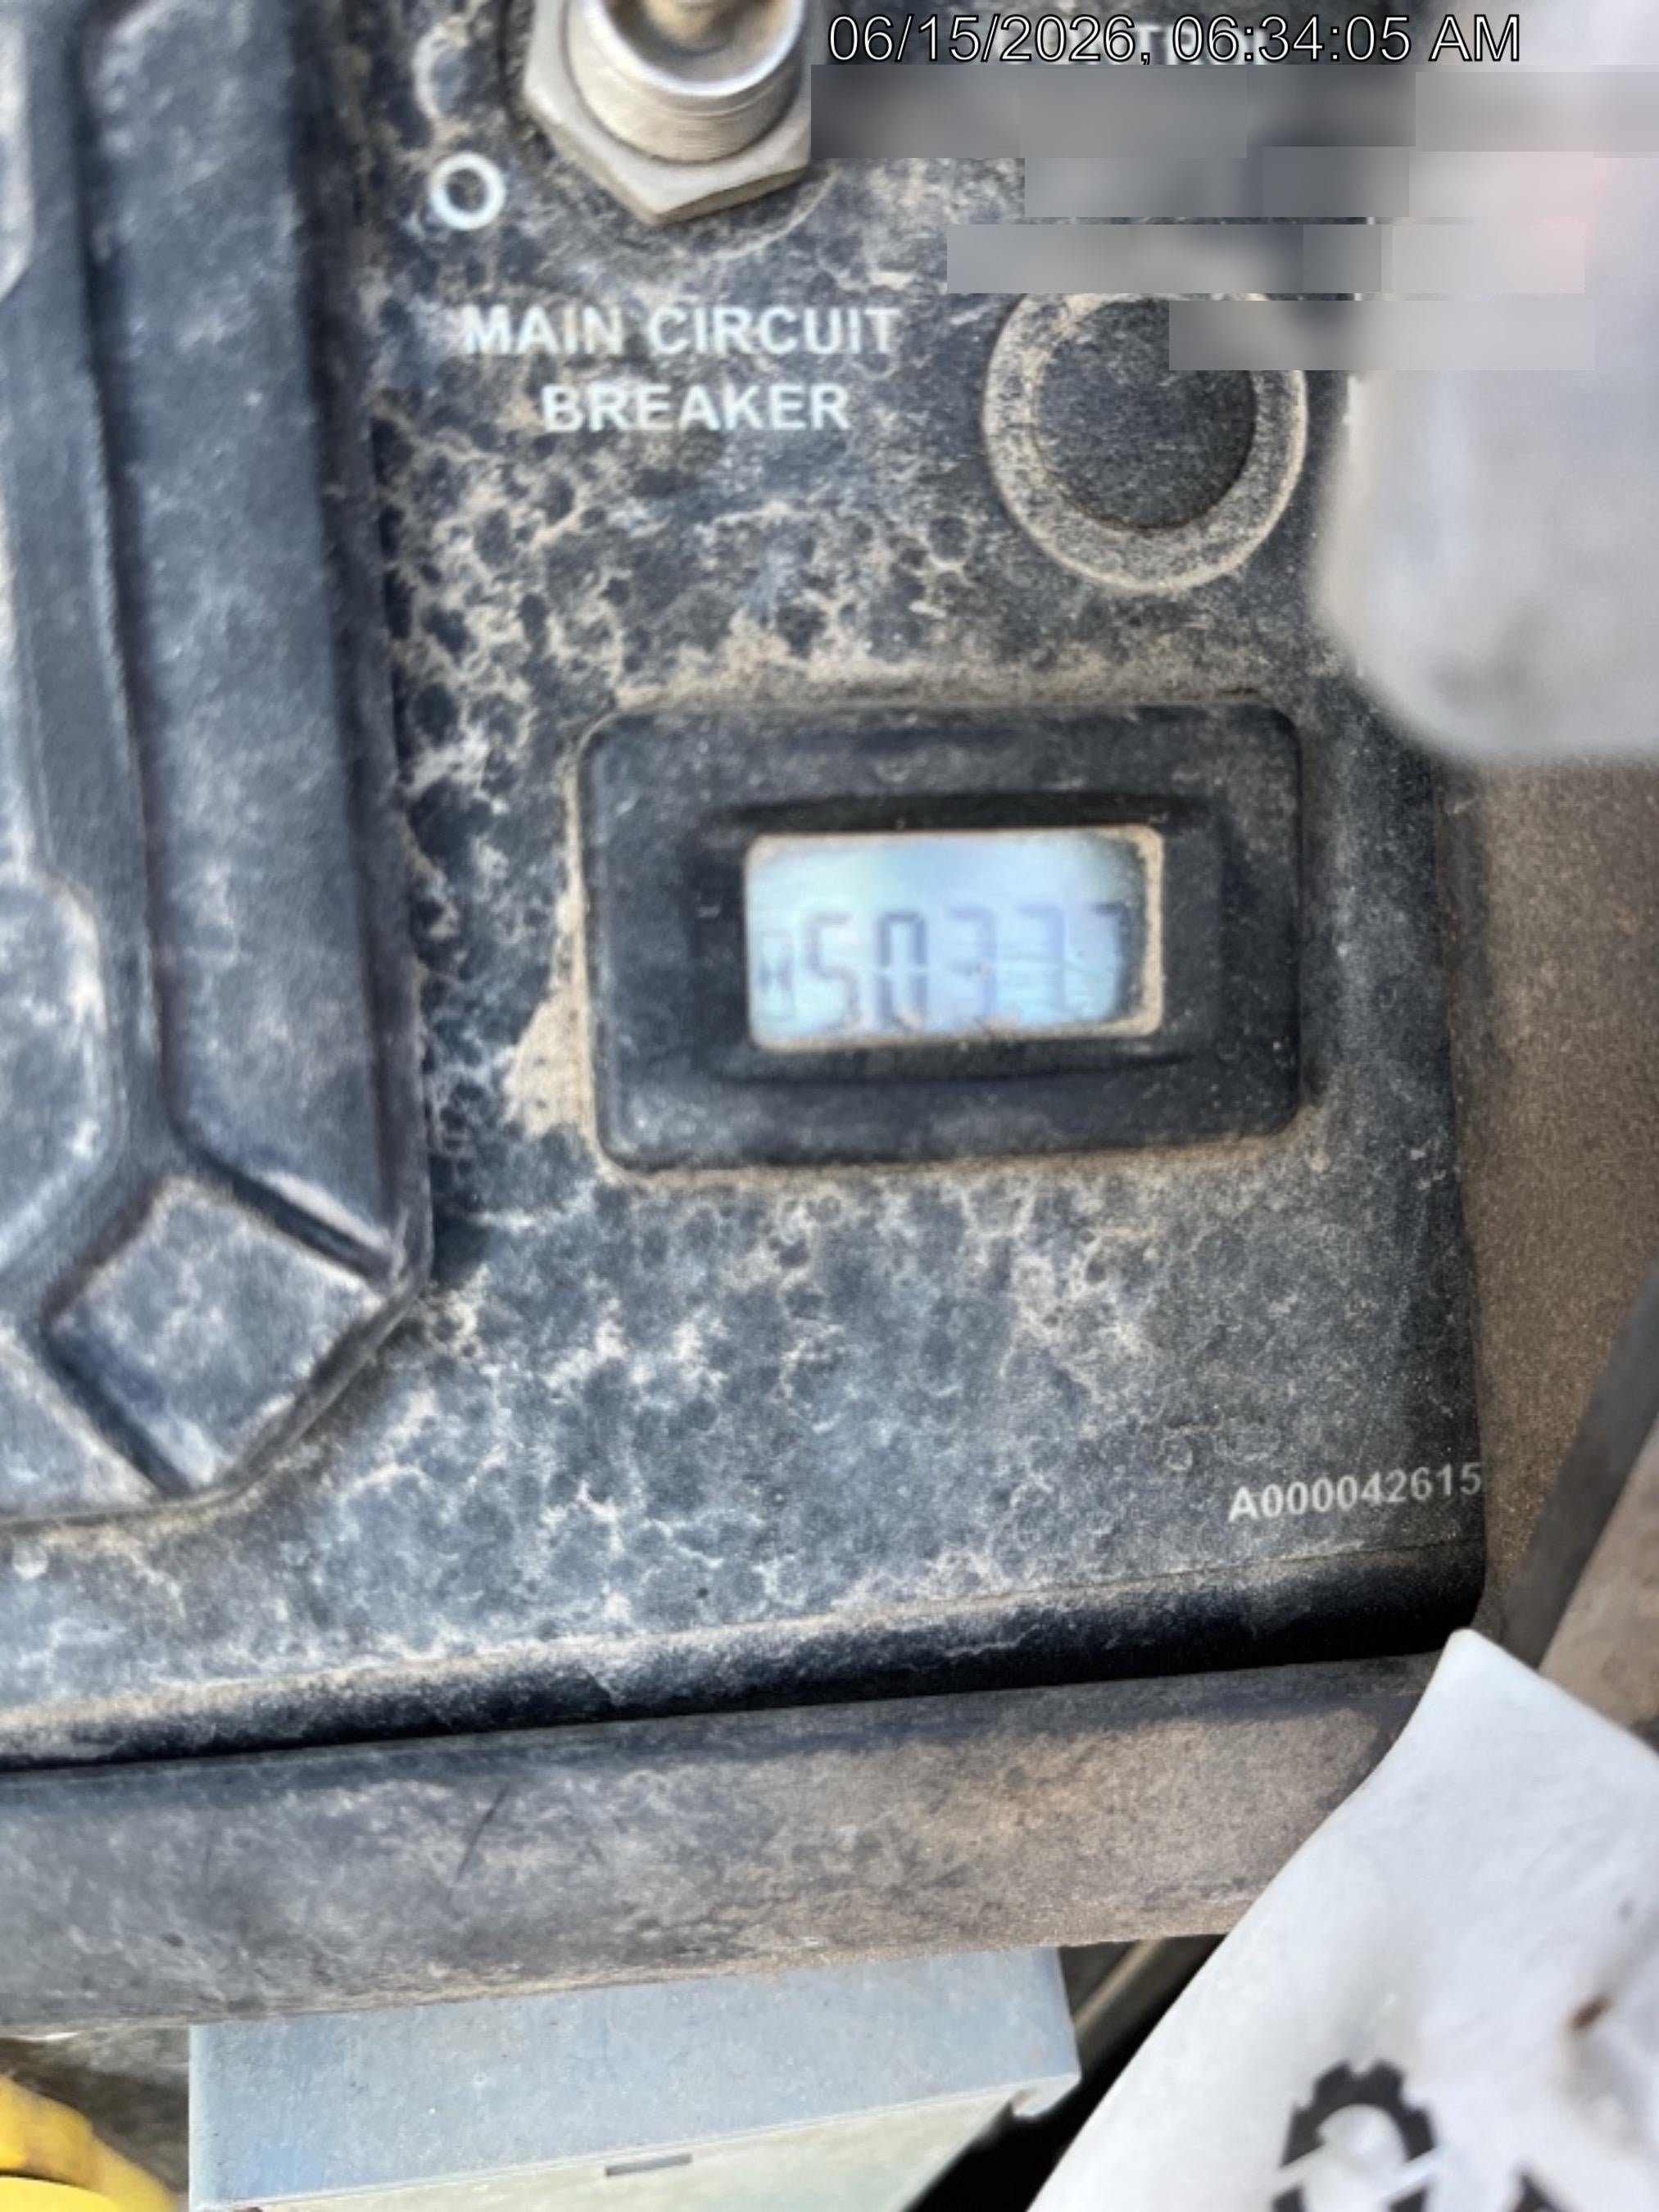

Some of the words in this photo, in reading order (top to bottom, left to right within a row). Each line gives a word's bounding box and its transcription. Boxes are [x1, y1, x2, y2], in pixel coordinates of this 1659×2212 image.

[461, 304, 623, 356] MAIN
[647, 304, 900, 356] CIRCUIT
[541, 383, 851, 433] BREAKER
[1229, 1461, 1481, 1521] A000042615
